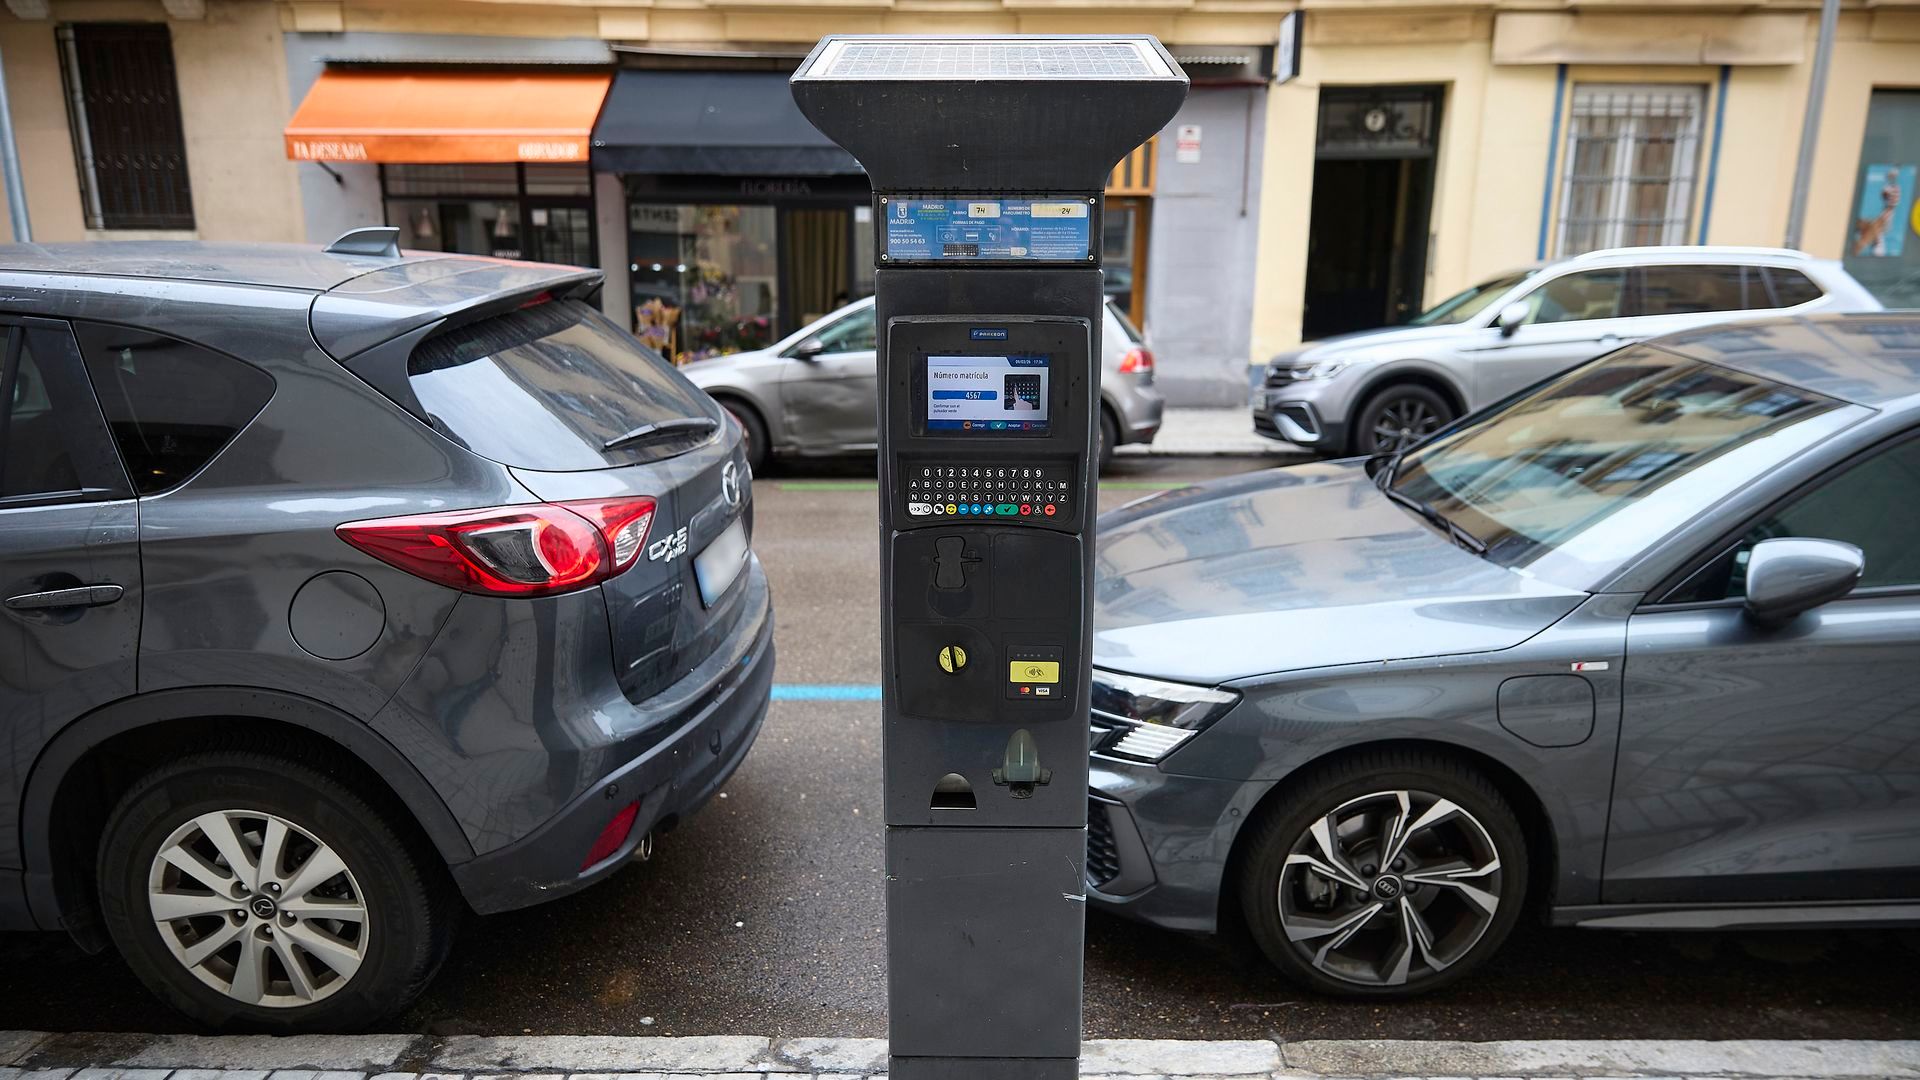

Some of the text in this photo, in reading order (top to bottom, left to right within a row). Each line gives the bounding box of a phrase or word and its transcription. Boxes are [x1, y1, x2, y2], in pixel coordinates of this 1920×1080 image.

[933, 371, 989, 380] Número matrícula
[965, 391, 982, 400] 4567
[648, 526, 688, 561] CX-5
[664, 543, 688, 563] AWD
